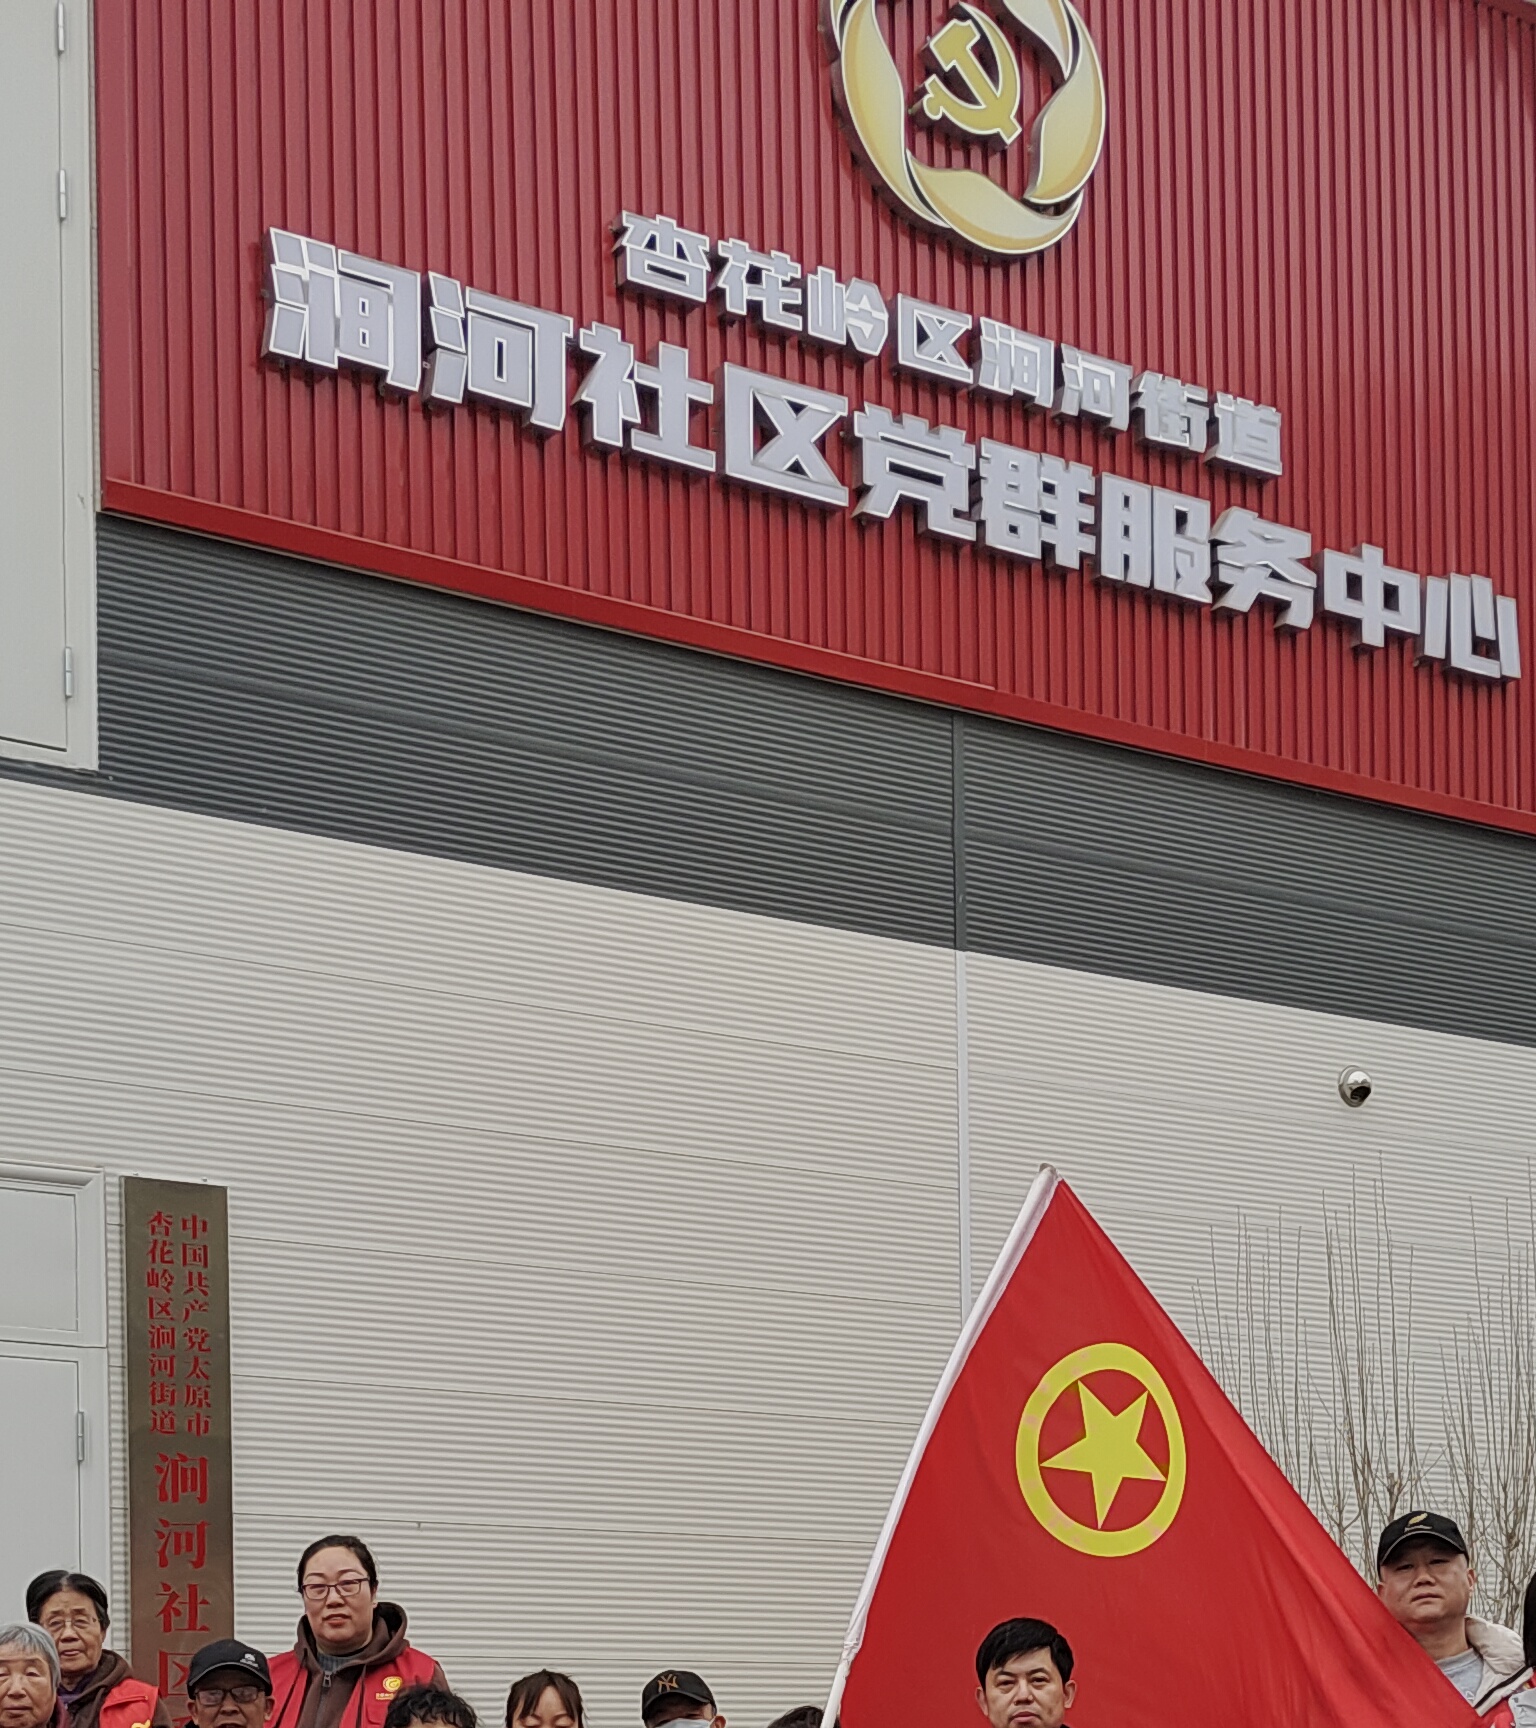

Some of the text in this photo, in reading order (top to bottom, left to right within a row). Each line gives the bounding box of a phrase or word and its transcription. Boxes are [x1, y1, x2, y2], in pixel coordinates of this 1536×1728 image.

[264, 226, 1522, 683] 涧河社区党群服务中心
[611, 209, 1284, 477] 杏花岭区涧河街道
[146, 1210, 177, 1437] 杏花岭区涧河街道
[181, 1212, 212, 1438] 中国共产党太原市
